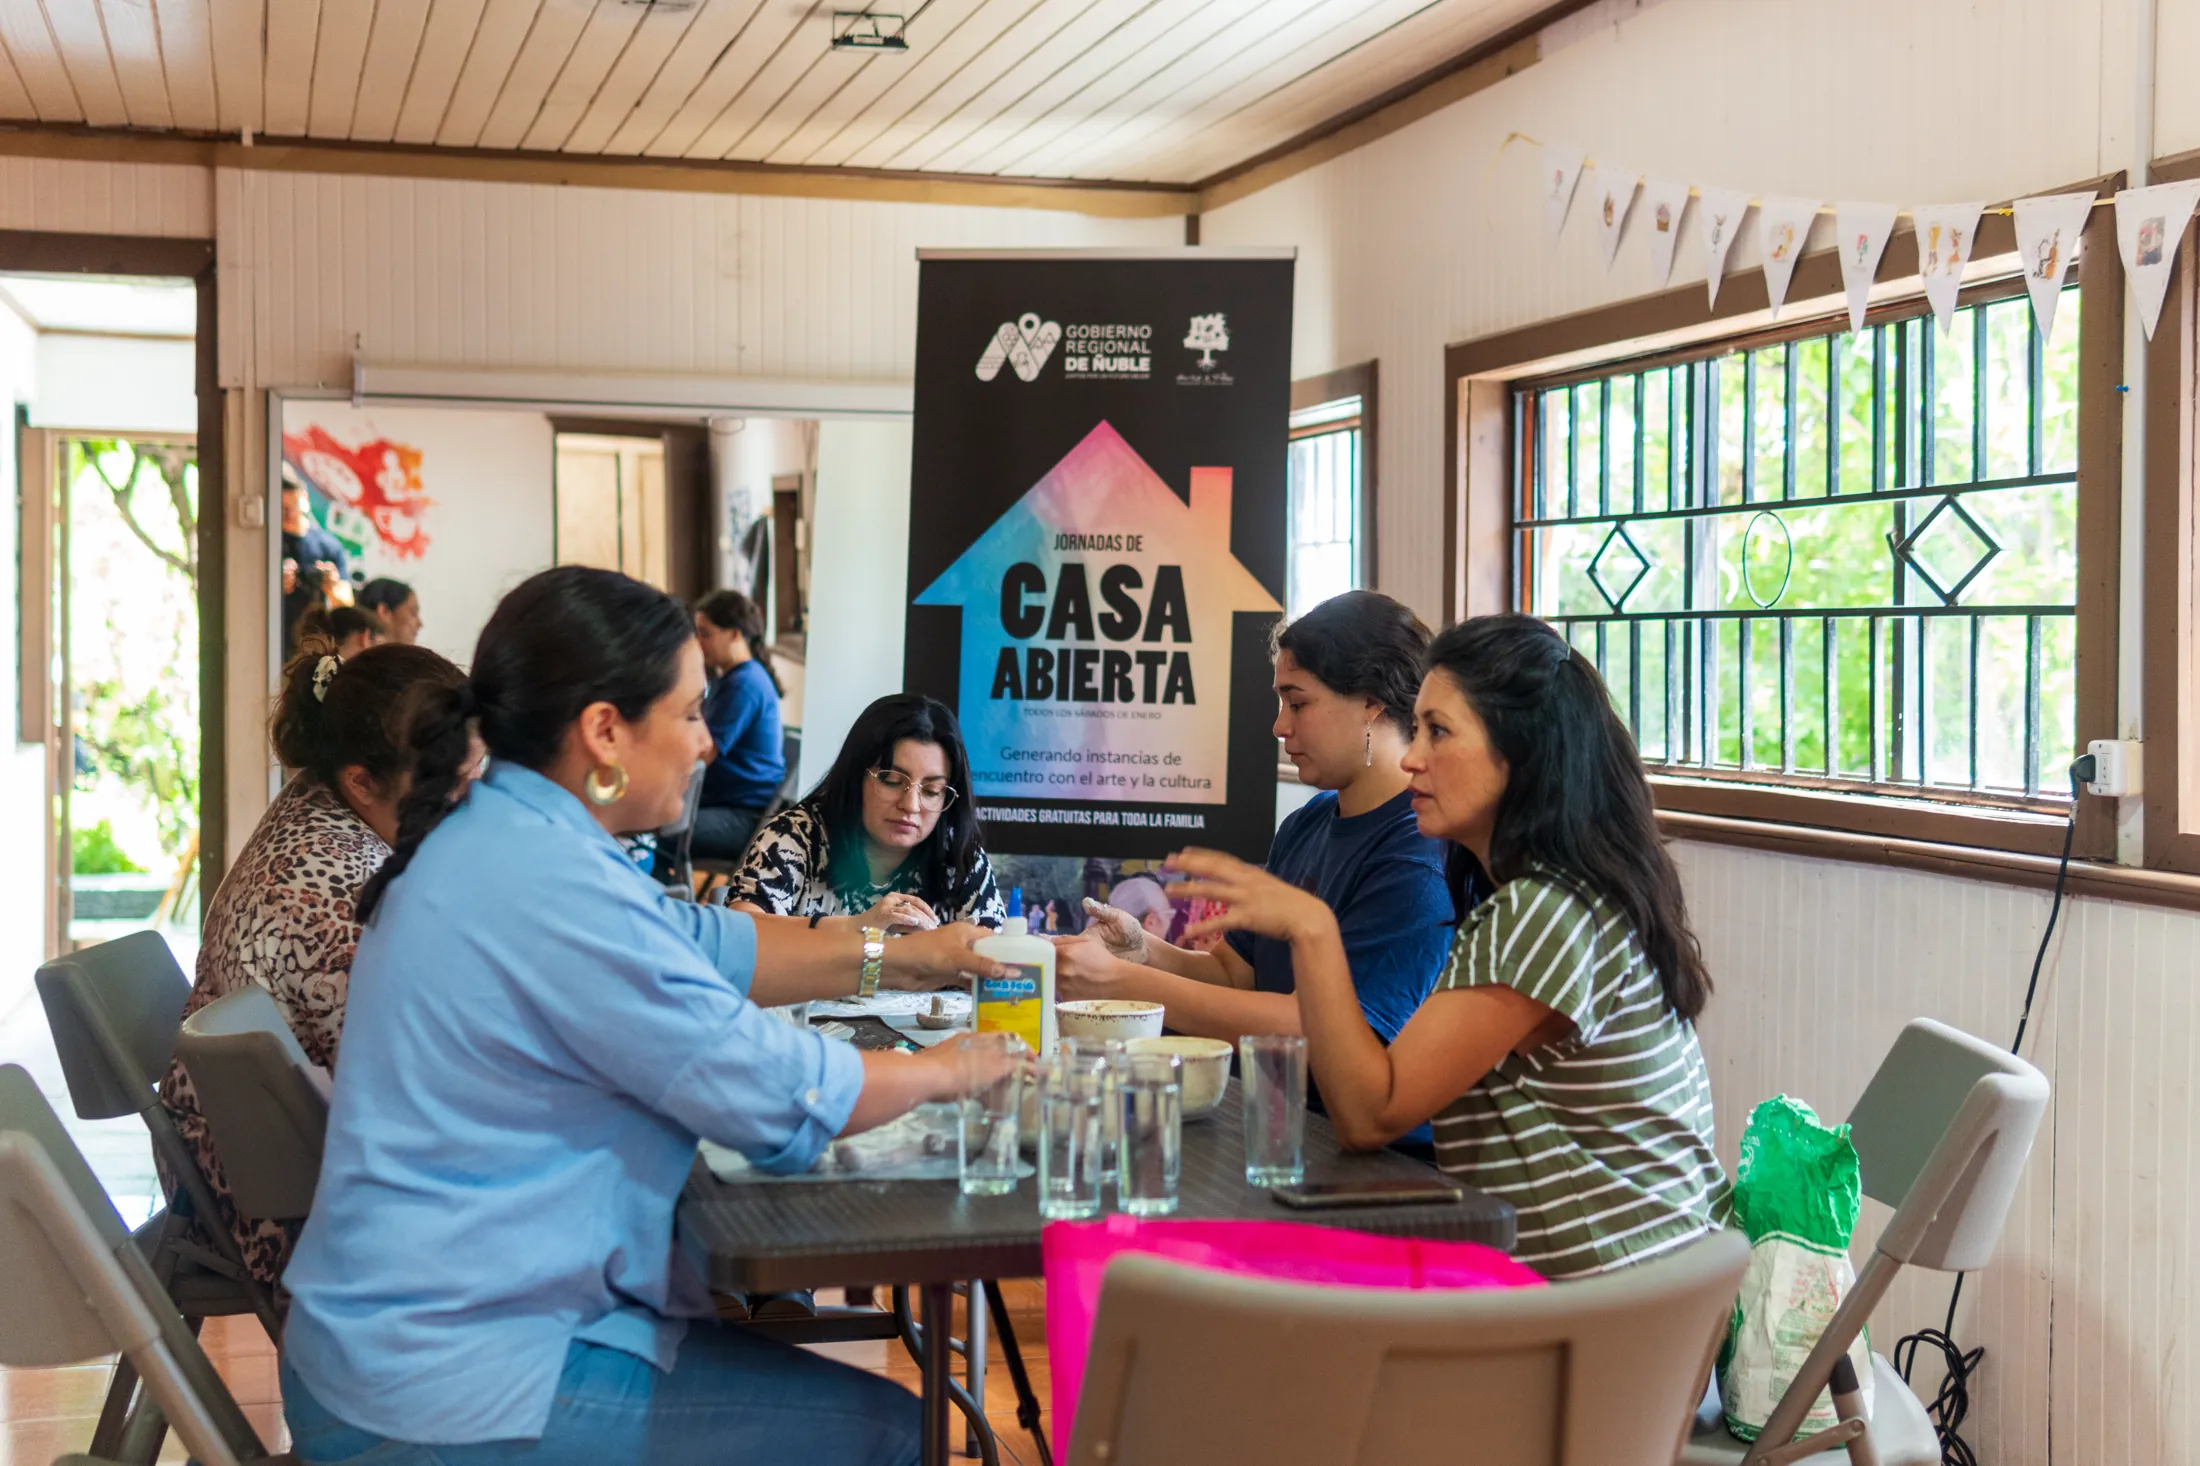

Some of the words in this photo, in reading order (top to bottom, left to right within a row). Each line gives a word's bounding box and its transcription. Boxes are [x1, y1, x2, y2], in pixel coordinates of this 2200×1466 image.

[1065, 324, 1152, 339] GOBIERNO
[1065, 340, 1151, 354] REGIONAL
[1065, 357, 1089, 371] DE
[1092, 354, 1151, 371] ÑUBLE
[1053, 534, 1122, 551] JORNADAS
[1126, 535, 1143, 551] DE
[1001, 562, 1192, 643] CASA
[990, 647, 1196, 705] ABIERTA
[1131, 712, 1162, 720] ENERO
[1000, 746, 1082, 762] Generando
[1086, 749, 1159, 765] instancias
[1163, 752, 1182, 765] de
[971, 769, 1044, 784] encuentro
[1048, 773, 1075, 784] con
[1080, 771, 1092, 785] el
[1096, 774, 1126, 786] arte
[1130, 776, 1139, 789] y
[1142, 773, 1155, 787] la
[1159, 774, 1212, 789] cultura
[975, 806, 1037, 823] ACTIVIDADES
[1038, 809, 1092, 825] GRATUITAS
[1093, 811, 1120, 825] PARA
[1121, 812, 1148, 827] TODA
[1149, 813, 1163, 827] LA
[1164, 814, 1205, 829] FAMILIA
